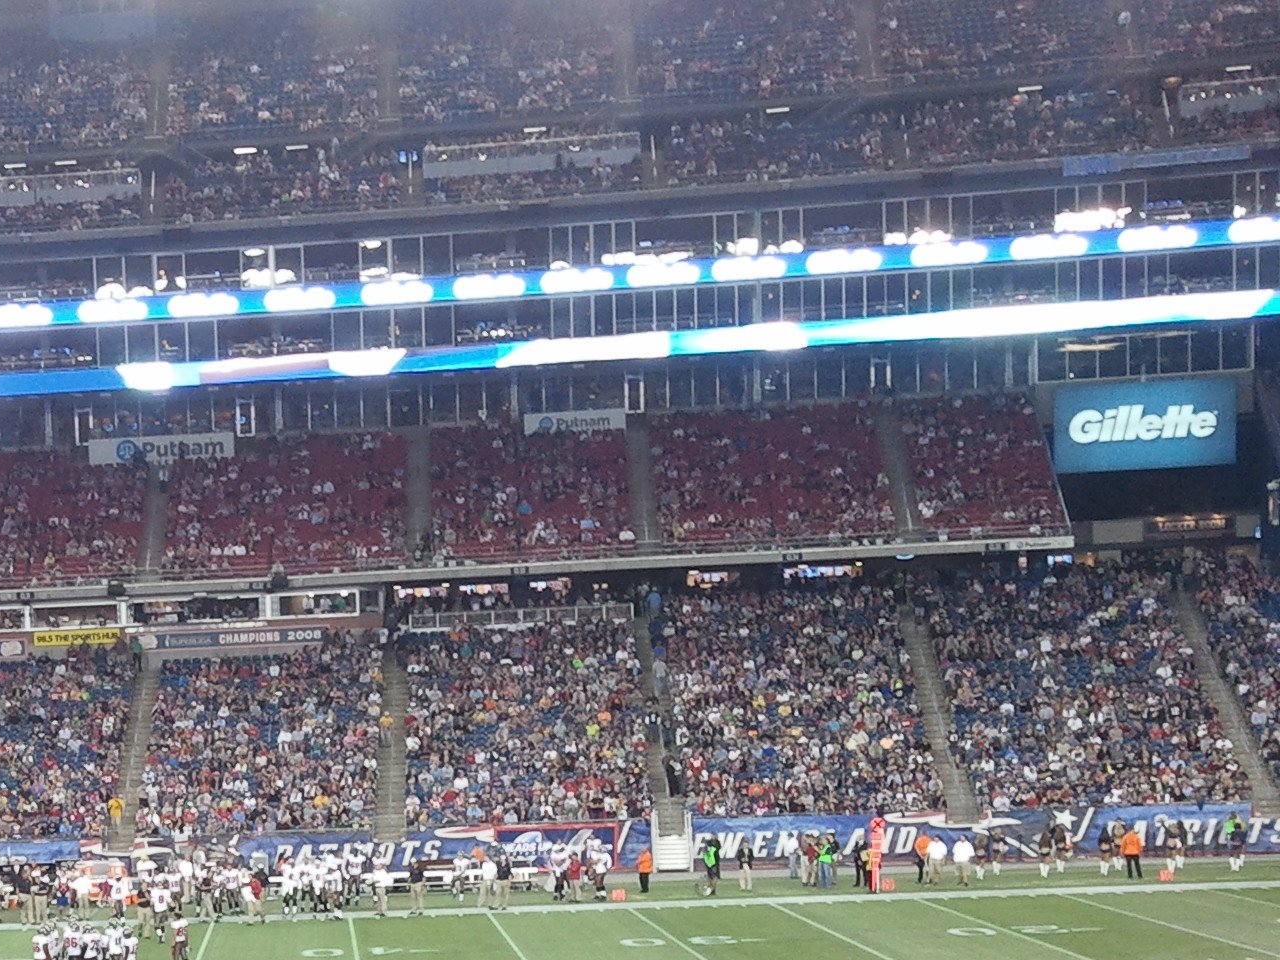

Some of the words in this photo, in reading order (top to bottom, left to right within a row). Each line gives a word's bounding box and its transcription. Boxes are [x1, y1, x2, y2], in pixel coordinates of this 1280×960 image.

[556, 417, 611, 430] Putnam
[1069, 404, 1217, 444] Gillette
[142, 440, 225, 458] Putnam
[54, 633, 70, 643] THE
[71, 631, 100, 643] SPORTS
[218, 631, 281, 644] CHAMPIONS
[287, 629, 322, 641] 2008
